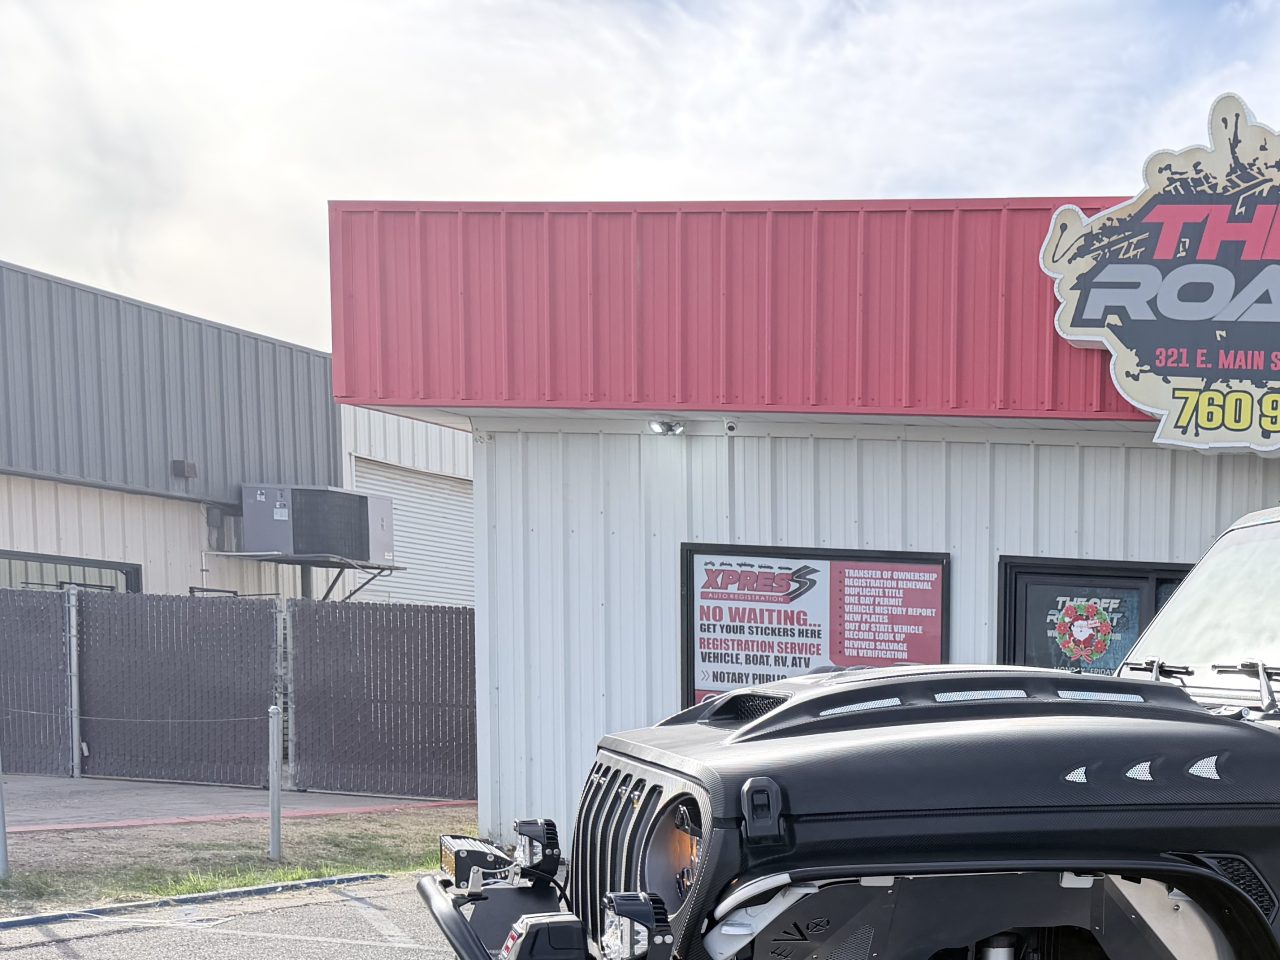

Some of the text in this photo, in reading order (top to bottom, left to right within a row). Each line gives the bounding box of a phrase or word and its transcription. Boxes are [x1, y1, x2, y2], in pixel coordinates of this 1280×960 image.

[1155, 347, 1190, 368] 321
[1196, 348, 1213, 369] E.
[1218, 349, 1265, 371] MAIN
[1172, 387, 1254, 431] 760
[844, 569, 937, 580] TRANSFER OF OWNERSHIP
[701, 565, 820, 601] XPRESS
[844, 578, 932, 589] REGISTRATION RENEWAL
[708, 592, 784, 602] AUTO REGISTRATION
[844, 587, 904, 597] DUPLICATE TITLE
[844, 596, 859, 604] ONE
[876, 598, 902, 606] PERMIT
[700, 605, 822, 627] NO WAITING...
[844, 604, 936, 616] VEHICLE HISTORY REPORT
[844, 613, 888, 622] NEW PLATES
[700, 624, 822, 639] GET YOUR STICKERS HERE
[844, 622, 923, 633] OUT OF STATE VEHICLE
[844, 631, 874, 639] RECORD
[875, 632, 894, 640] LOOK
[699, 637, 822, 656] REGISTRATION SERVICE
[844, 640, 908, 651] REVIVED SALVAGE
[700, 651, 811, 668] VEHICLE, BOAT, RV, ATV
[844, 648, 908, 660] VIN VERIFICATION
[712, 671, 750, 684] NOTARY
